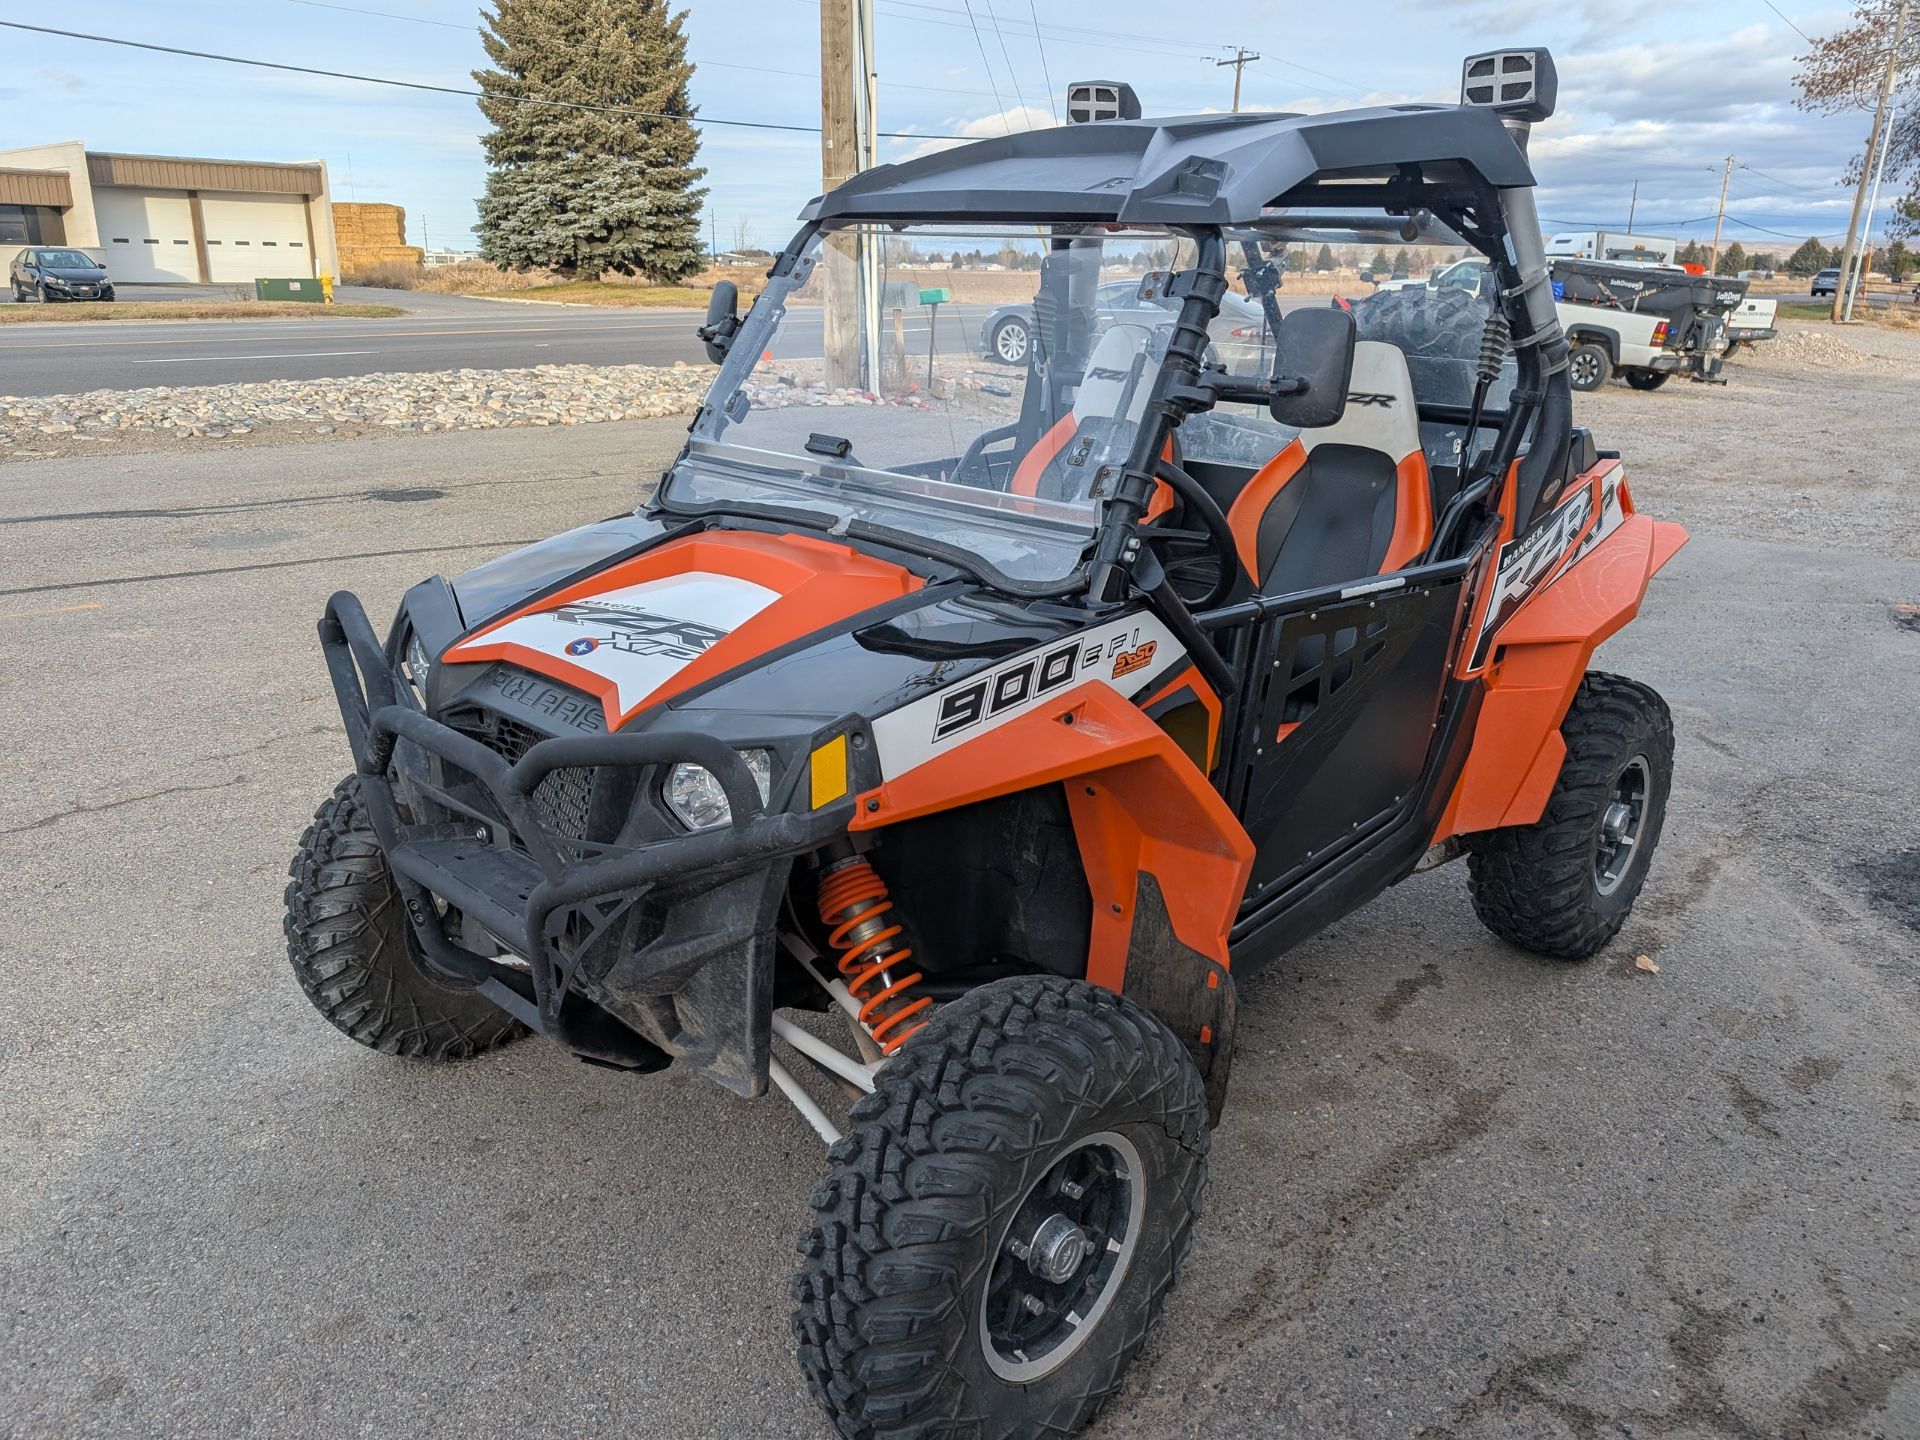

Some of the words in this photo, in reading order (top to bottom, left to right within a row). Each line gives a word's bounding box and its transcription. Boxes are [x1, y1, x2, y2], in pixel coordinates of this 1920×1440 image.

[1482, 488, 1592, 632] RZR
[1503, 525, 1544, 568] RANGER
[538, 603, 731, 650] RZR
[579, 600, 645, 611] RANGER
[598, 631, 704, 660] XP
[486, 669, 605, 732] POLARIS
[932, 637, 1085, 744] 900
[1081, 627, 1140, 670] EFI
